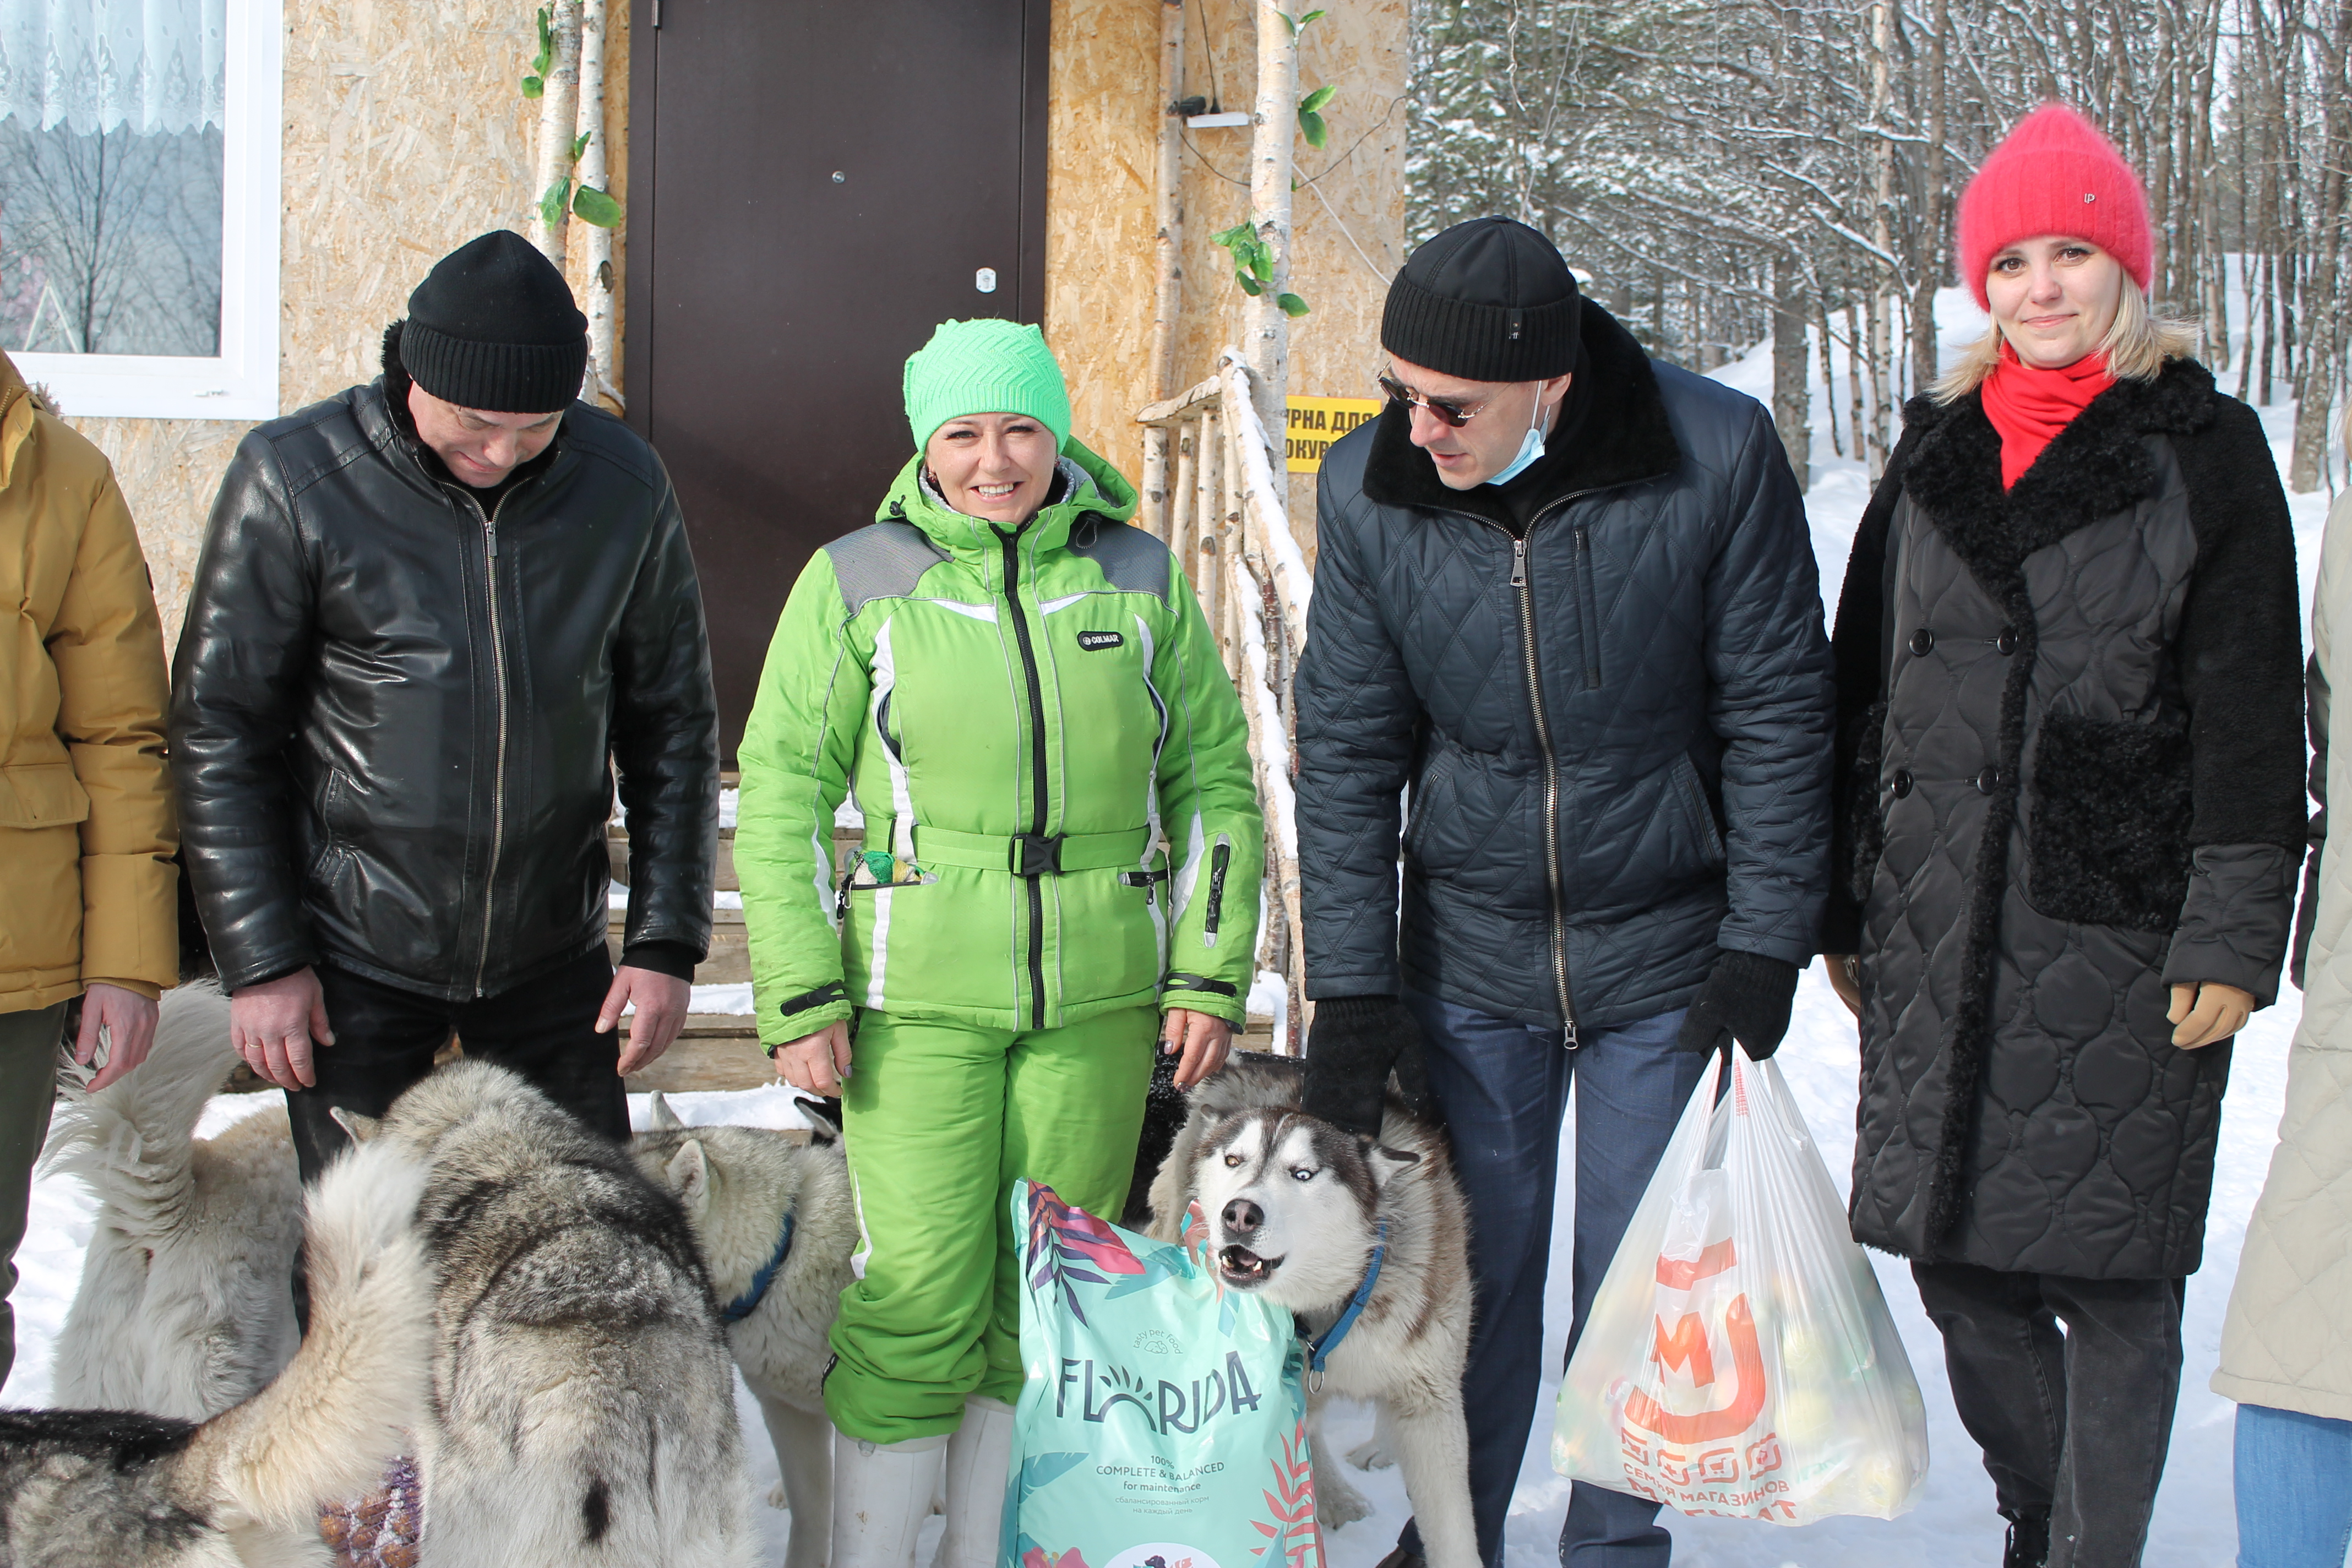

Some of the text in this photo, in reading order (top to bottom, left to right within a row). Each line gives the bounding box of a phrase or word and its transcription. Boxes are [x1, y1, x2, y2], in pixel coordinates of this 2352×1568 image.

[1286, 439, 1334, 460] ОКУР
[1091, 634, 1119, 644] COLMAR
[1133, 1329, 1183, 1354] tasty pet food
[1056, 1350, 1262, 1436] FLORIDA
[1096, 1462, 1224, 1482] COMPLETE & BALANCED
[1151, 1455, 1175, 1469] 100%
[1123, 1480, 1201, 1493] for maintenance
[1623, 1463, 1676, 1499] СЕМЬЯ
[1679, 1480, 1790, 1507] МАГАЗИНОВ
[1115, 1495, 1209, 1506] сбалансированный корм
